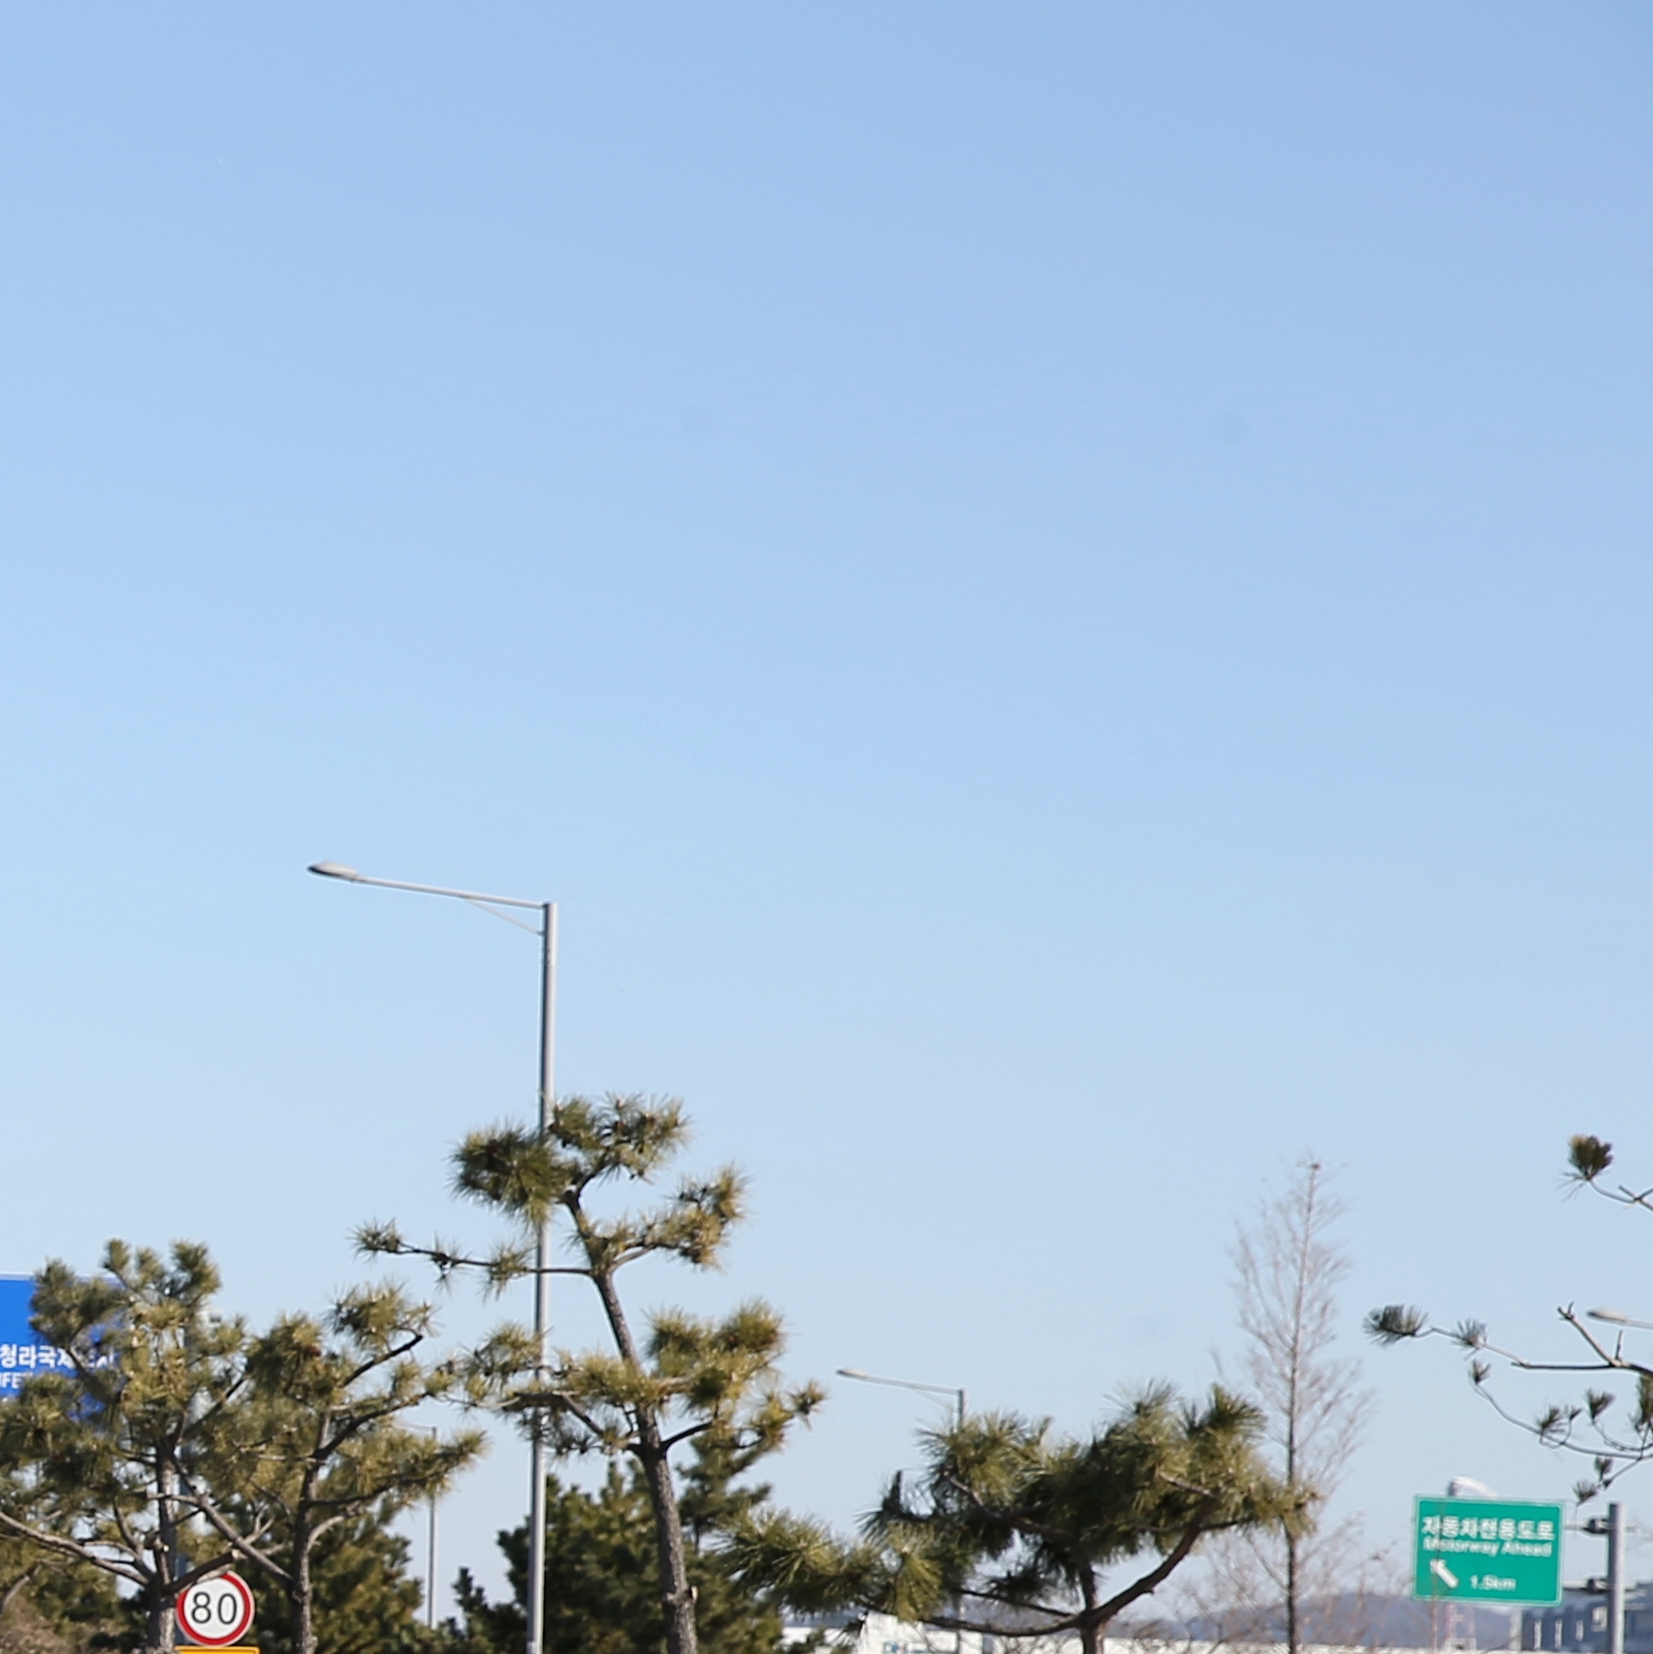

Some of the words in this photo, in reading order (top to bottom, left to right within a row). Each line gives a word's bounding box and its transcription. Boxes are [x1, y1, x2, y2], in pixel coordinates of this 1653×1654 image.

[1421, 1514, 1556, 1541] 자동차전용도로
[1423, 1536, 1500, 1557] Motorway
[1501, 1541, 1552, 1557] Ahead
[191, 1591, 238, 1626] 80
